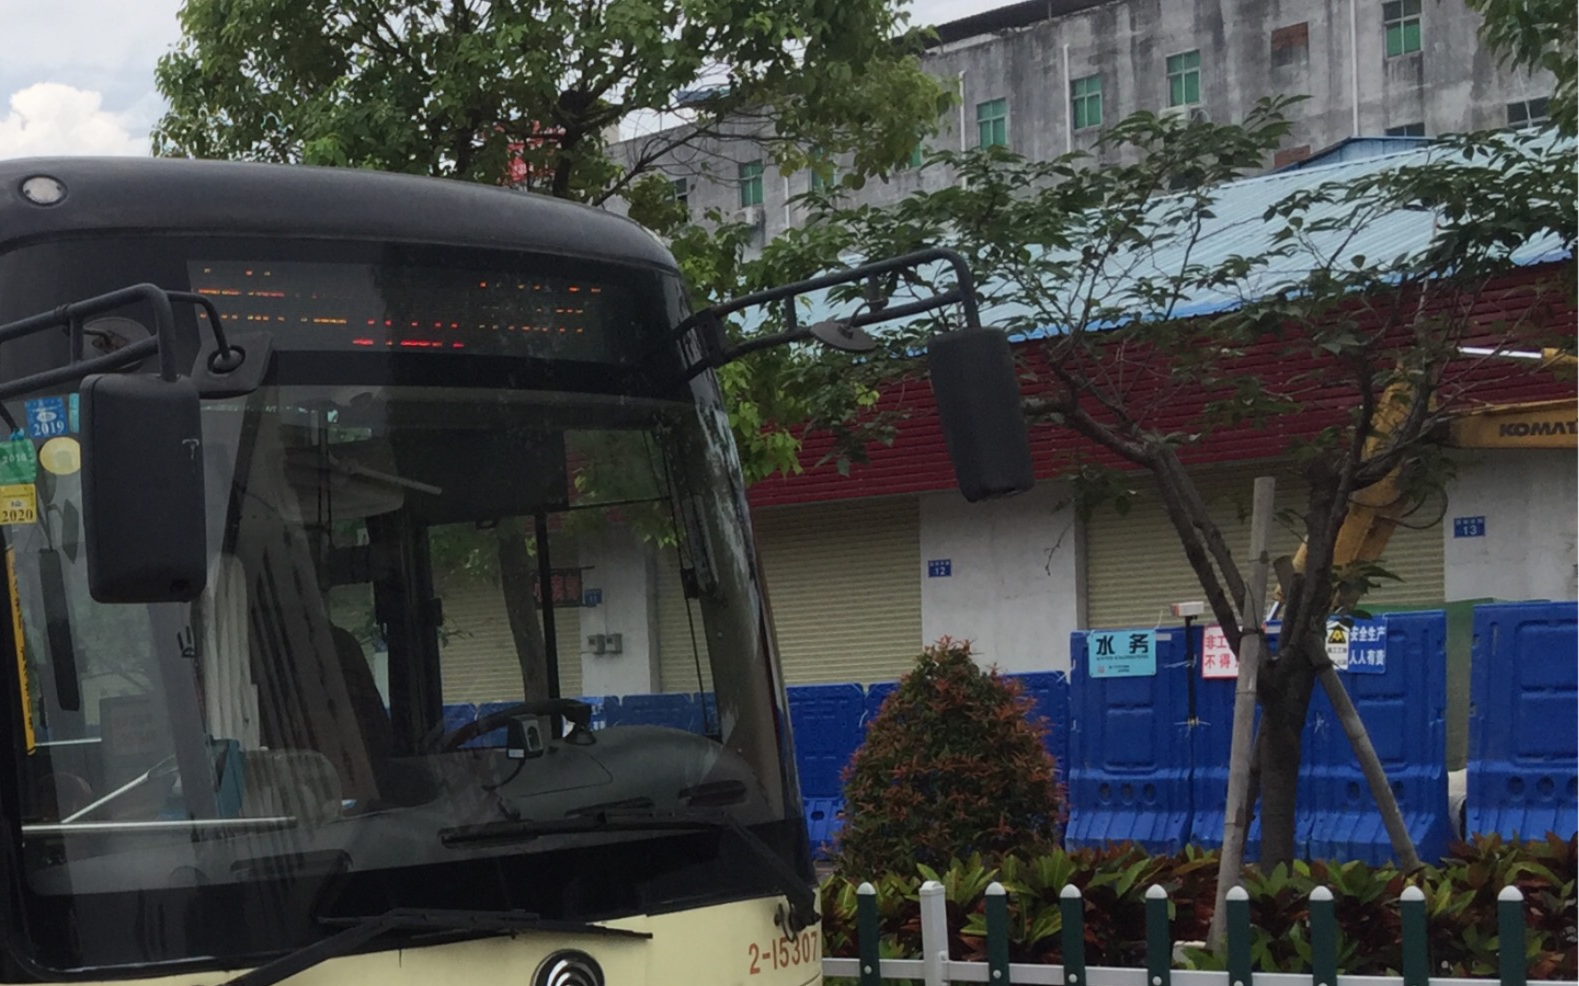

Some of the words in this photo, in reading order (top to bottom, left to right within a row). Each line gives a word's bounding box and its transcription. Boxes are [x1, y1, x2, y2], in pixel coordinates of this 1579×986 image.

[32, 420, 65, 437] 2019
[2, 508, 34, 523] 2020
[1463, 524, 1477, 536] 13
[1350, 625, 1386, 641] 安全生产
[1095, 633, 1149, 655] 水务
[748, 930, 818, 975] 2-15307
